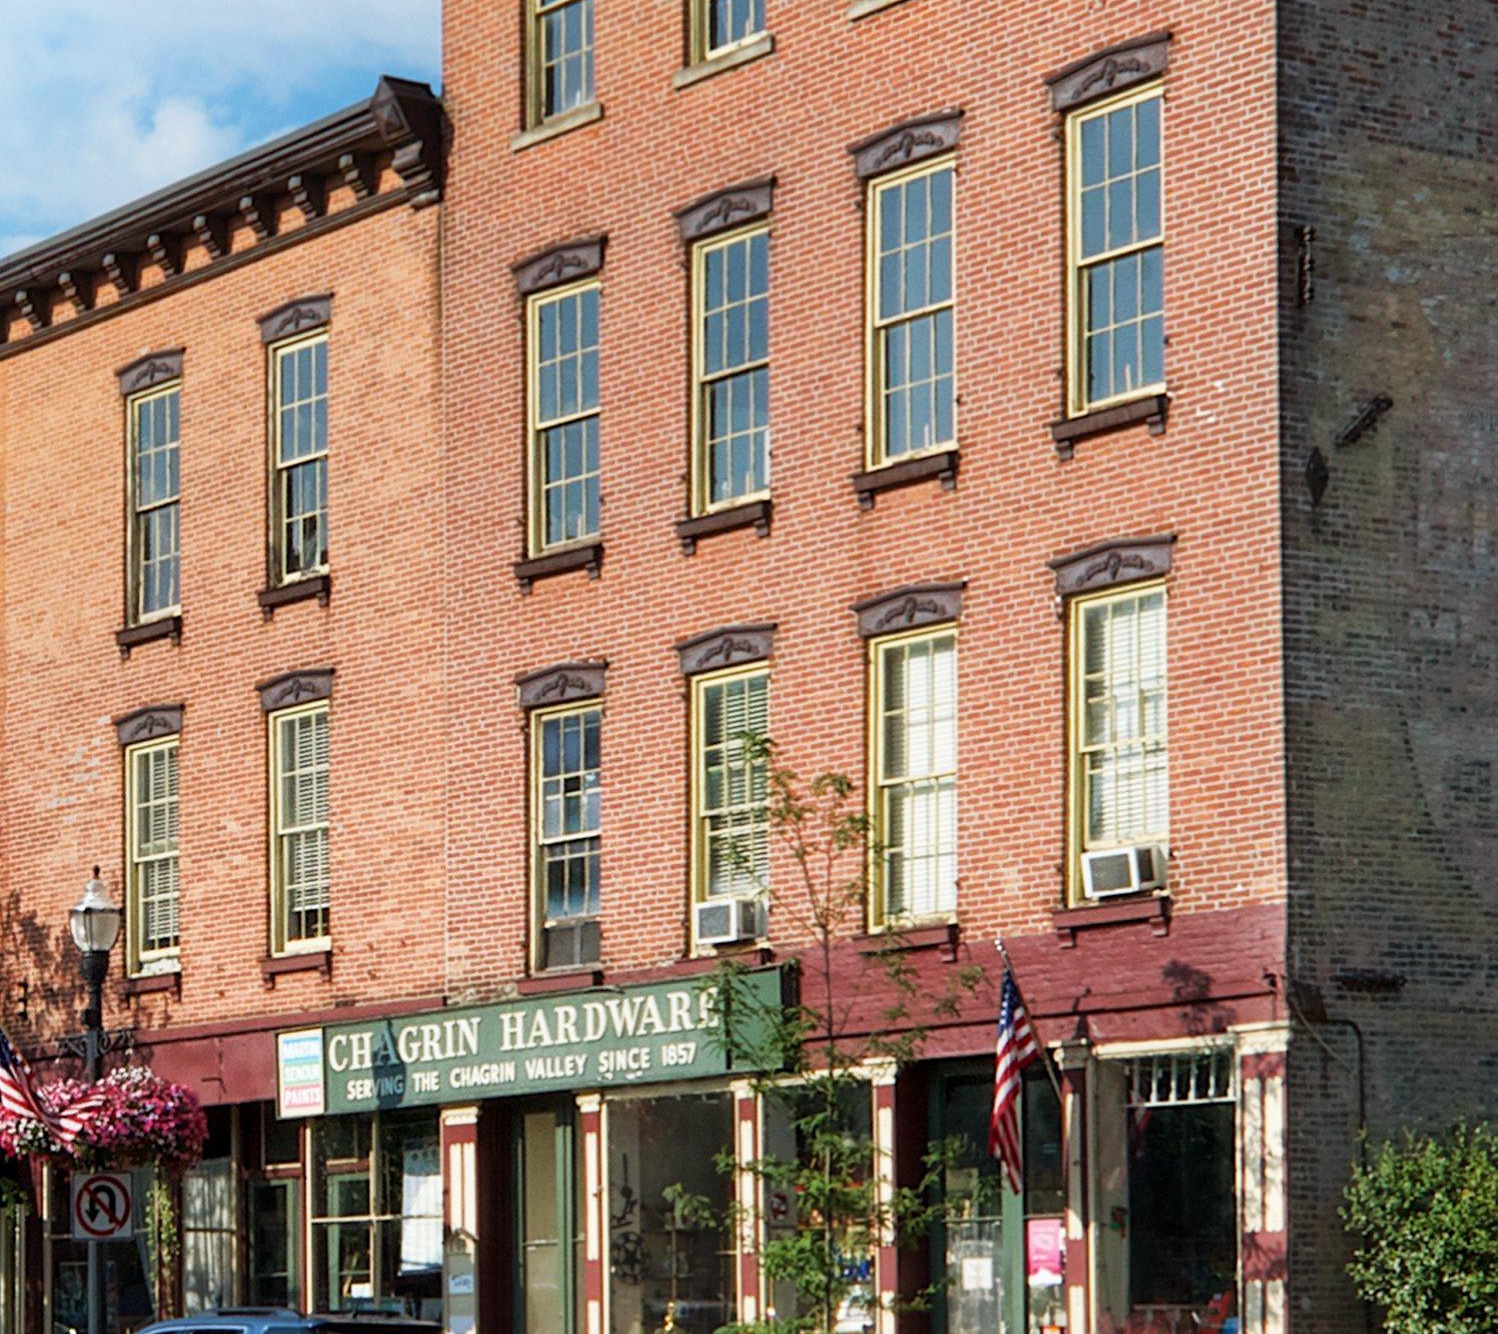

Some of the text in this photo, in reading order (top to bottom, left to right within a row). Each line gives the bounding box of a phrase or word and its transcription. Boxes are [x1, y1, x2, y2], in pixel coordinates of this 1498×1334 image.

[328, 987, 720, 1073] CHAGRIN HARDWARE
[346, 1040, 698, 1102] SERVING THE CHAGRIN VALLEY SINCE 1857
